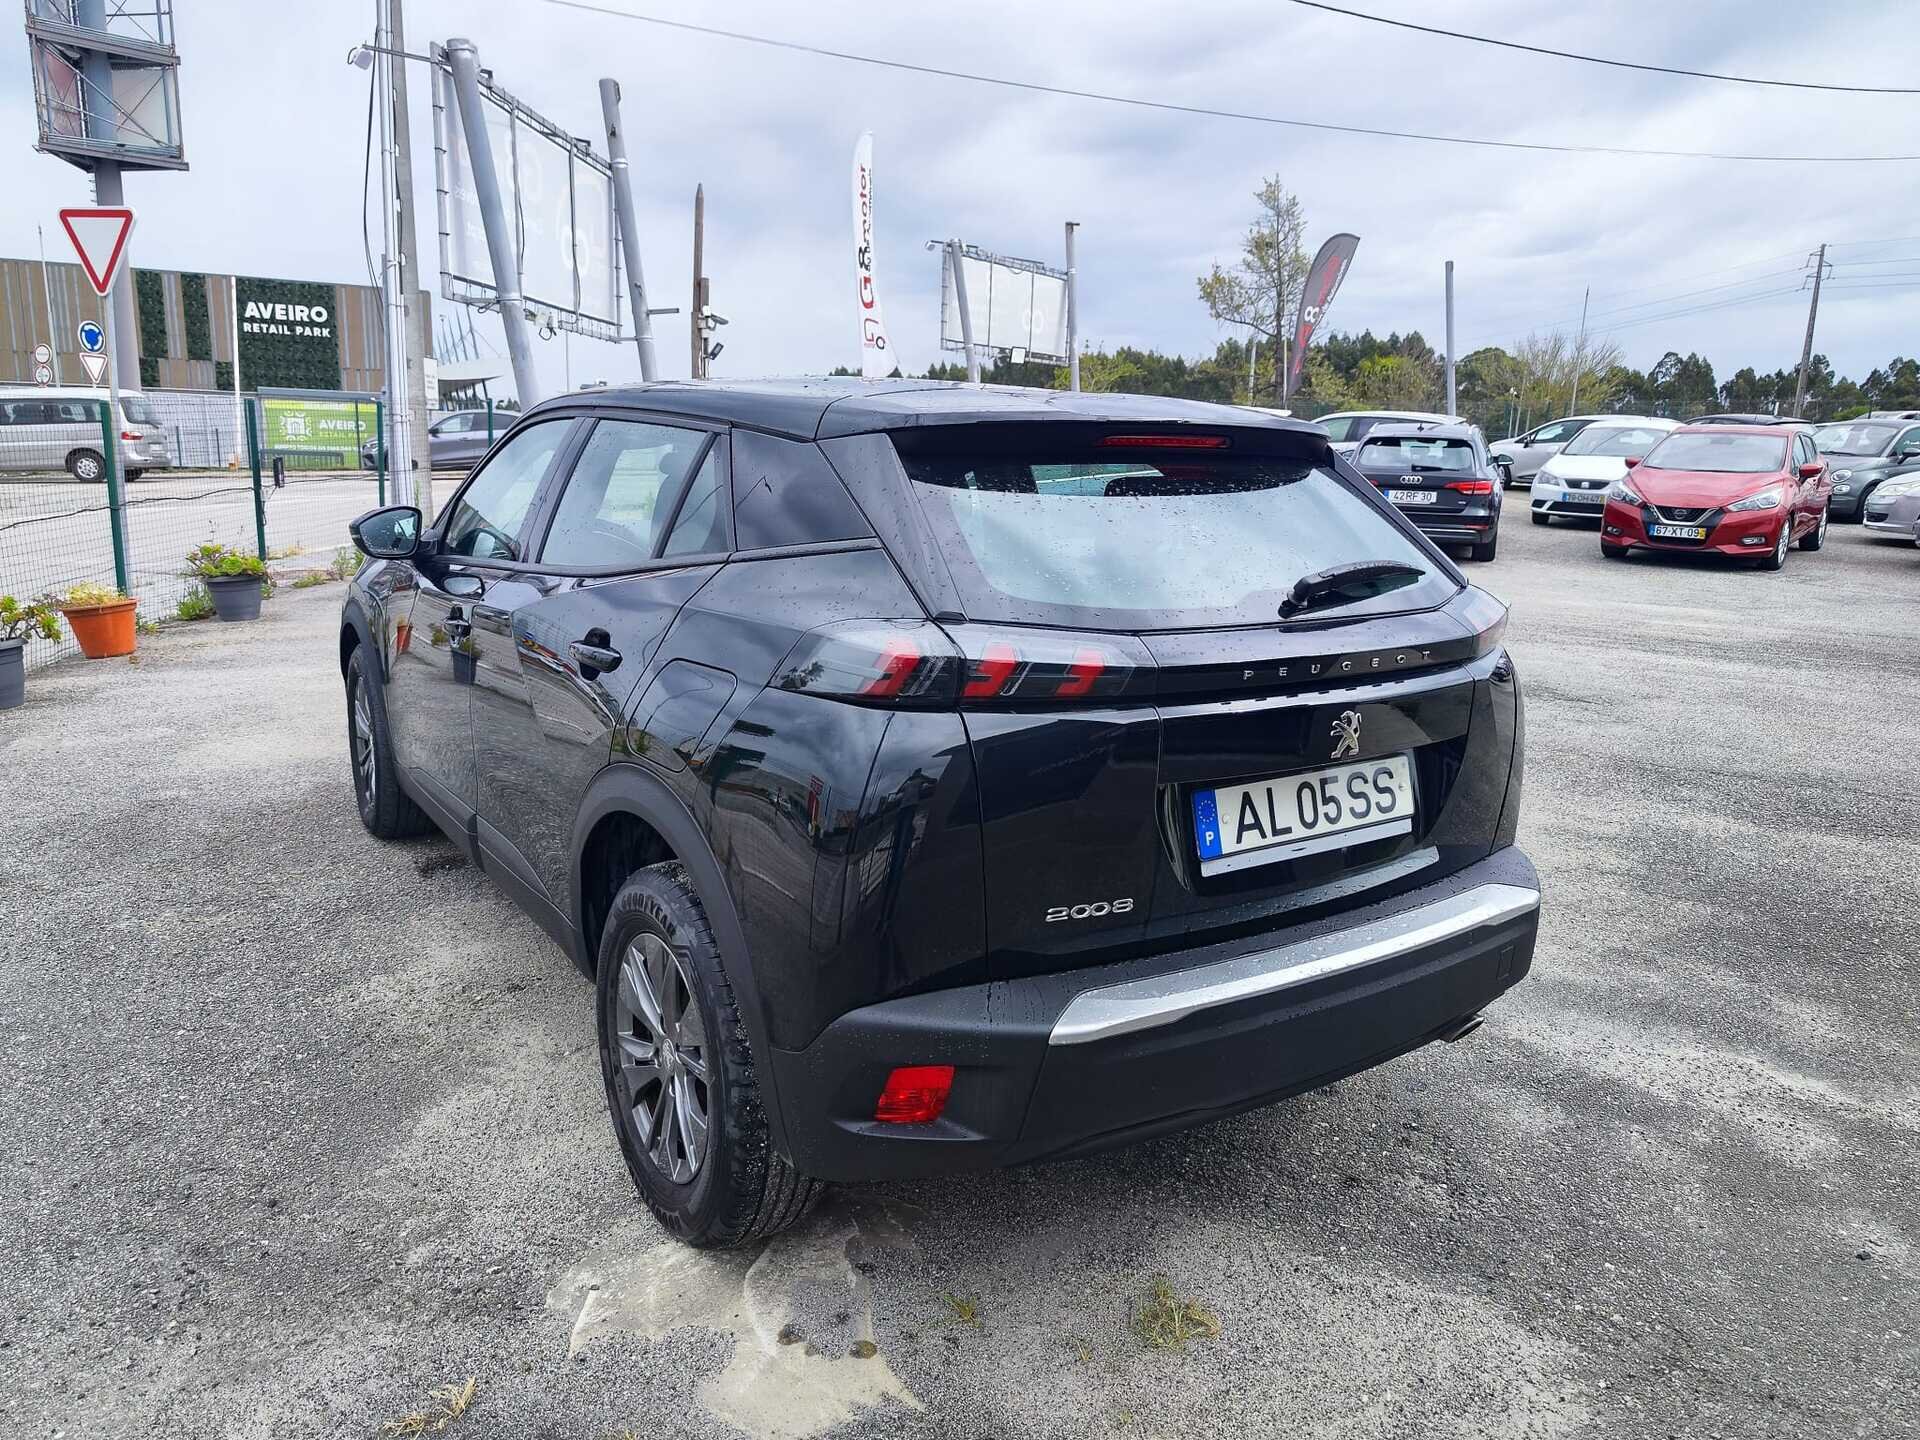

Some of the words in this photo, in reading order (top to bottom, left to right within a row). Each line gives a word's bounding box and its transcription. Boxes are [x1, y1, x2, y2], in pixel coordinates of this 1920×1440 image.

[244, 301, 328, 323] AVEIRO
[243, 322, 290, 335] RETAIL
[295, 326, 331, 337] PARK
[319, 419, 367, 431] AVEIRO
[1243, 650, 1431, 680] PEUGEOT
[1205, 831, 1214, 847] P
[1045, 898, 1134, 922] 2008
